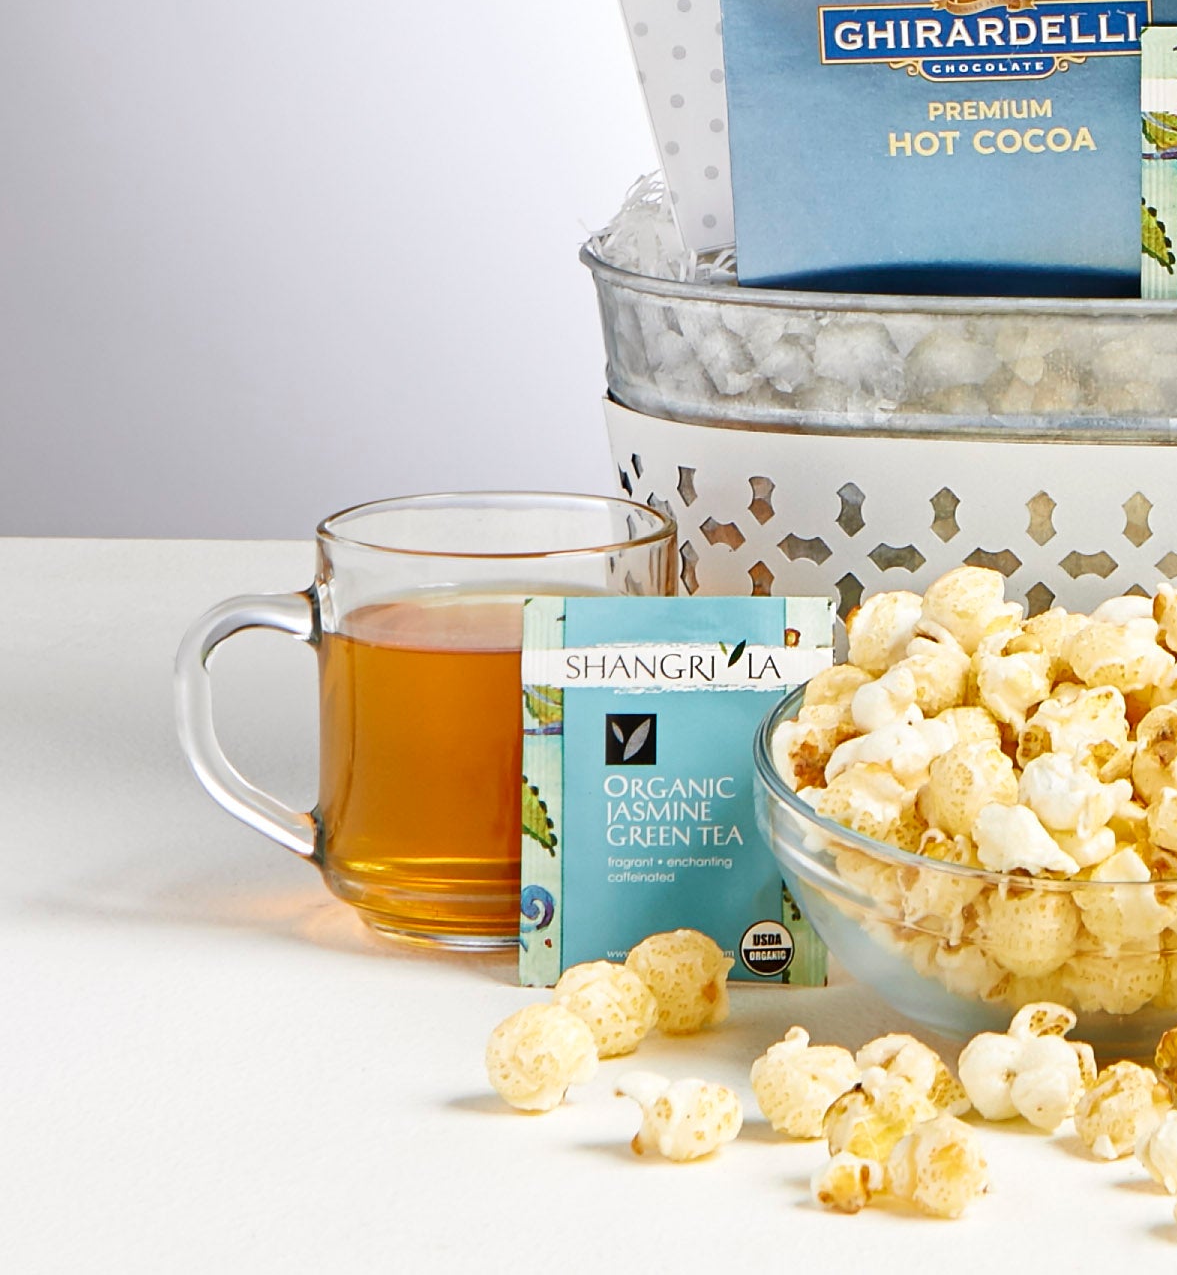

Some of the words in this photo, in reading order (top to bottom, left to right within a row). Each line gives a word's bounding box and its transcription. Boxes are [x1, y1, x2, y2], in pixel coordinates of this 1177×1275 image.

[833, 12, 1141, 51] GHIRARDELLI
[931, 60, 1045, 74] CHOCOLATE
[928, 99, 1053, 122] PREMIUM
[888, 130, 960, 158] HOT
[972, 126, 1098, 155] COCOA
[566, 653, 716, 682] SHANGRI
[747, 654, 781, 680] LA
[604, 775, 736, 800] ORGANIC
[607, 800, 712, 825] JASMINE
[606, 825, 690, 849] GREEN
[698, 826, 744, 847] TEA
[608, 856, 654, 869] fragrant
[666, 856, 733, 869] enchanting
[607, 872, 675, 883] caffeinated
[753, 934, 782, 946] USDA
[749, 950, 786, 961] ORGANIC
